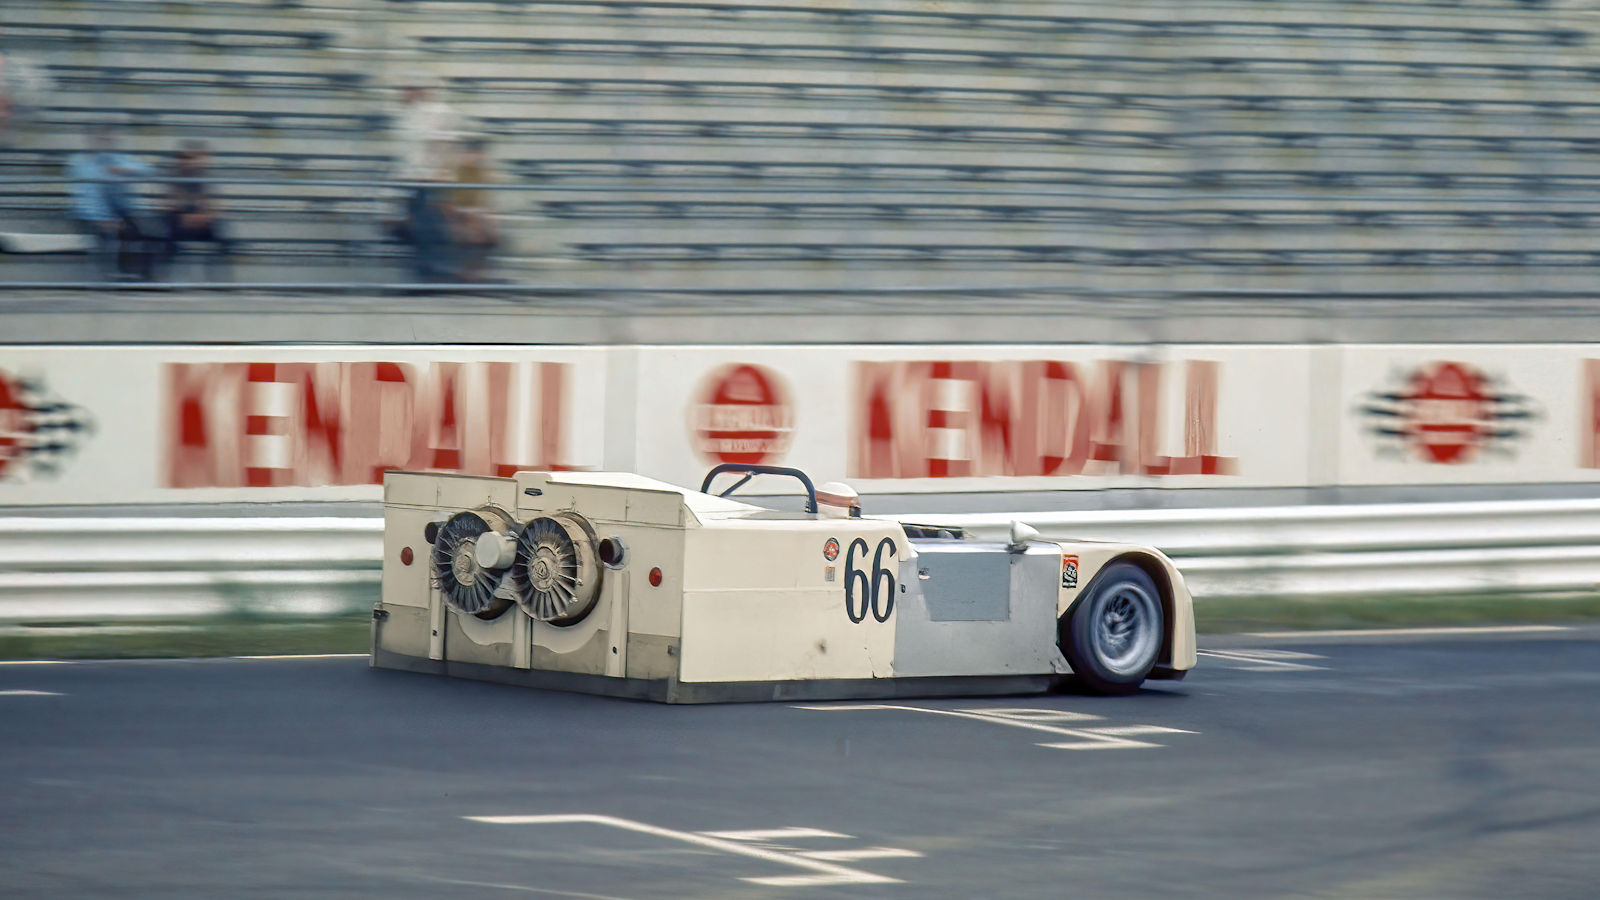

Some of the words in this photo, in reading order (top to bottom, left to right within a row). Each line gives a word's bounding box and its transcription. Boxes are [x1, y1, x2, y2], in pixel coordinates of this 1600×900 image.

[162, 362, 592, 487] KENDALL
[850, 360, 1238, 478] KENDALL
[844, 536, 897, 624] 66
